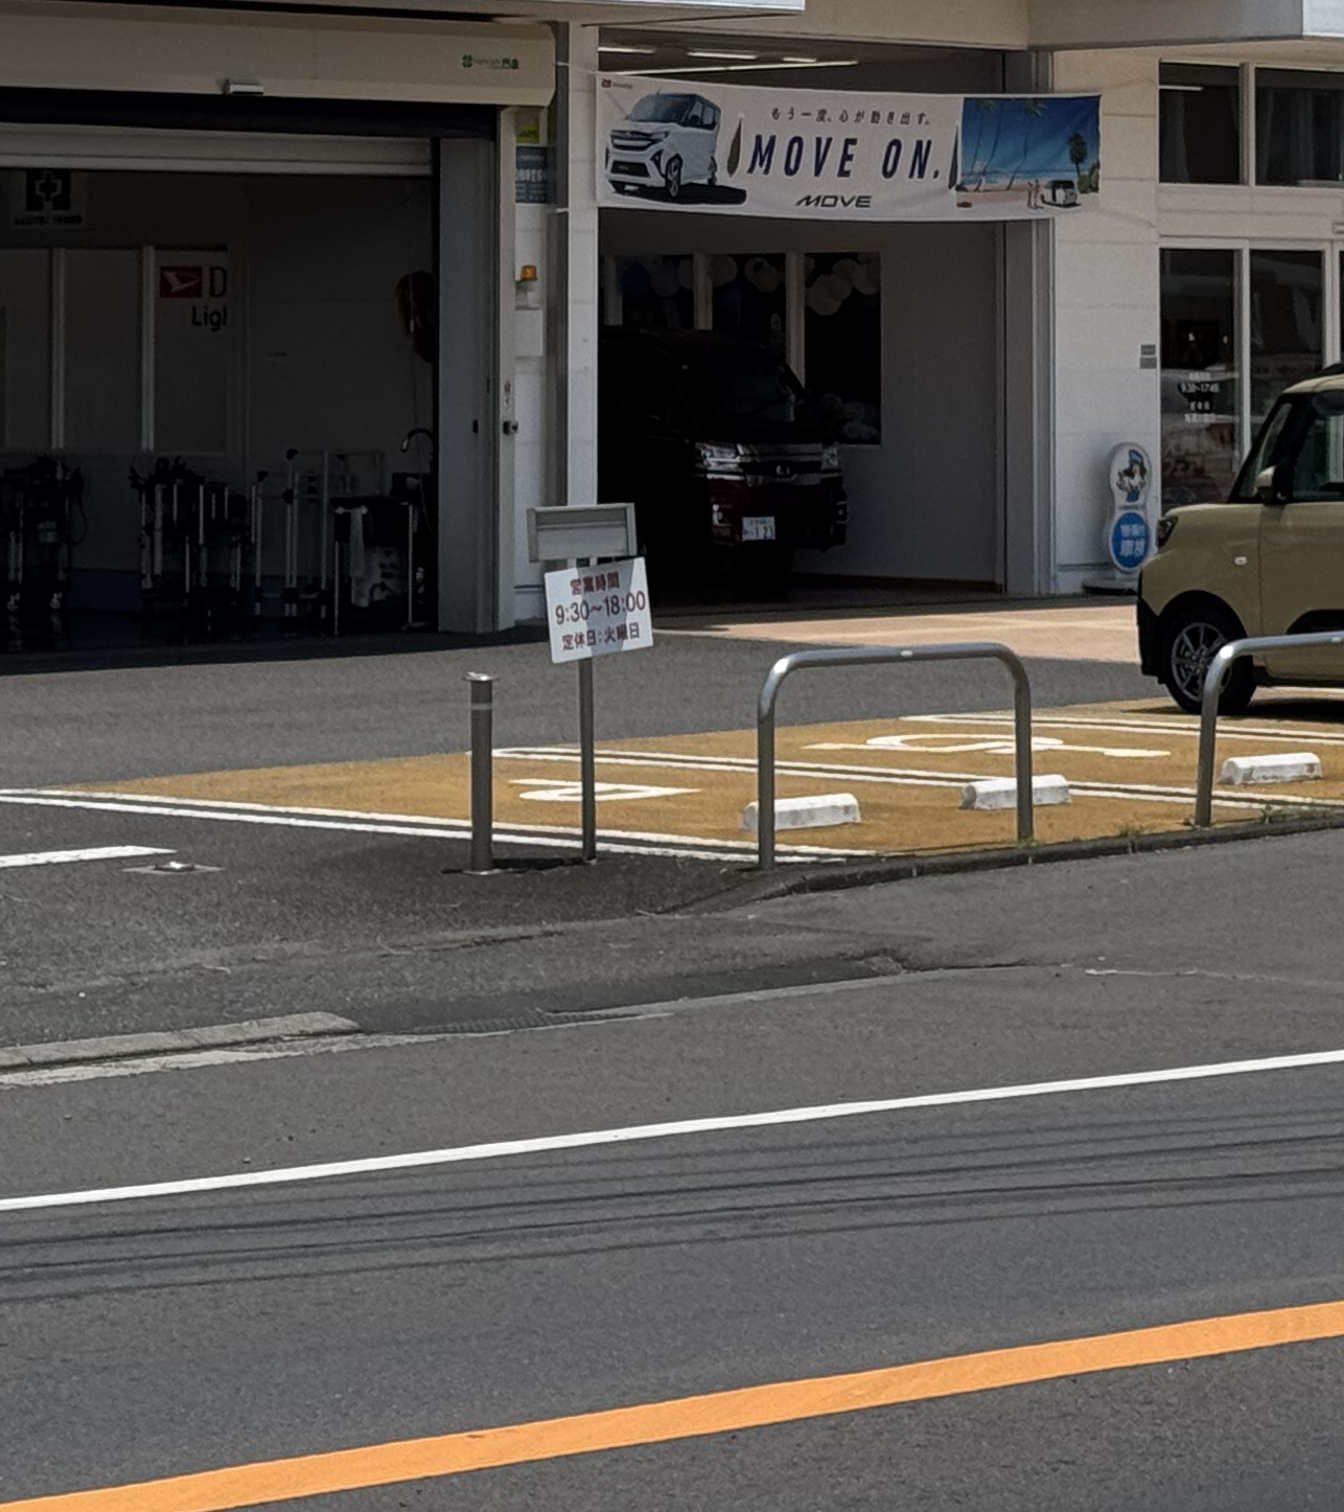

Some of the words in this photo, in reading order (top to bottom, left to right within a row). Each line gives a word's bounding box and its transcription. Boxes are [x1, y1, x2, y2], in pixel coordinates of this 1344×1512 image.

[747, 134, 859, 178] MOVE
[881, 138, 940, 180] ON.
[795, 194, 873, 208] MOVE
[570, 570, 621, 596] 営業時間
